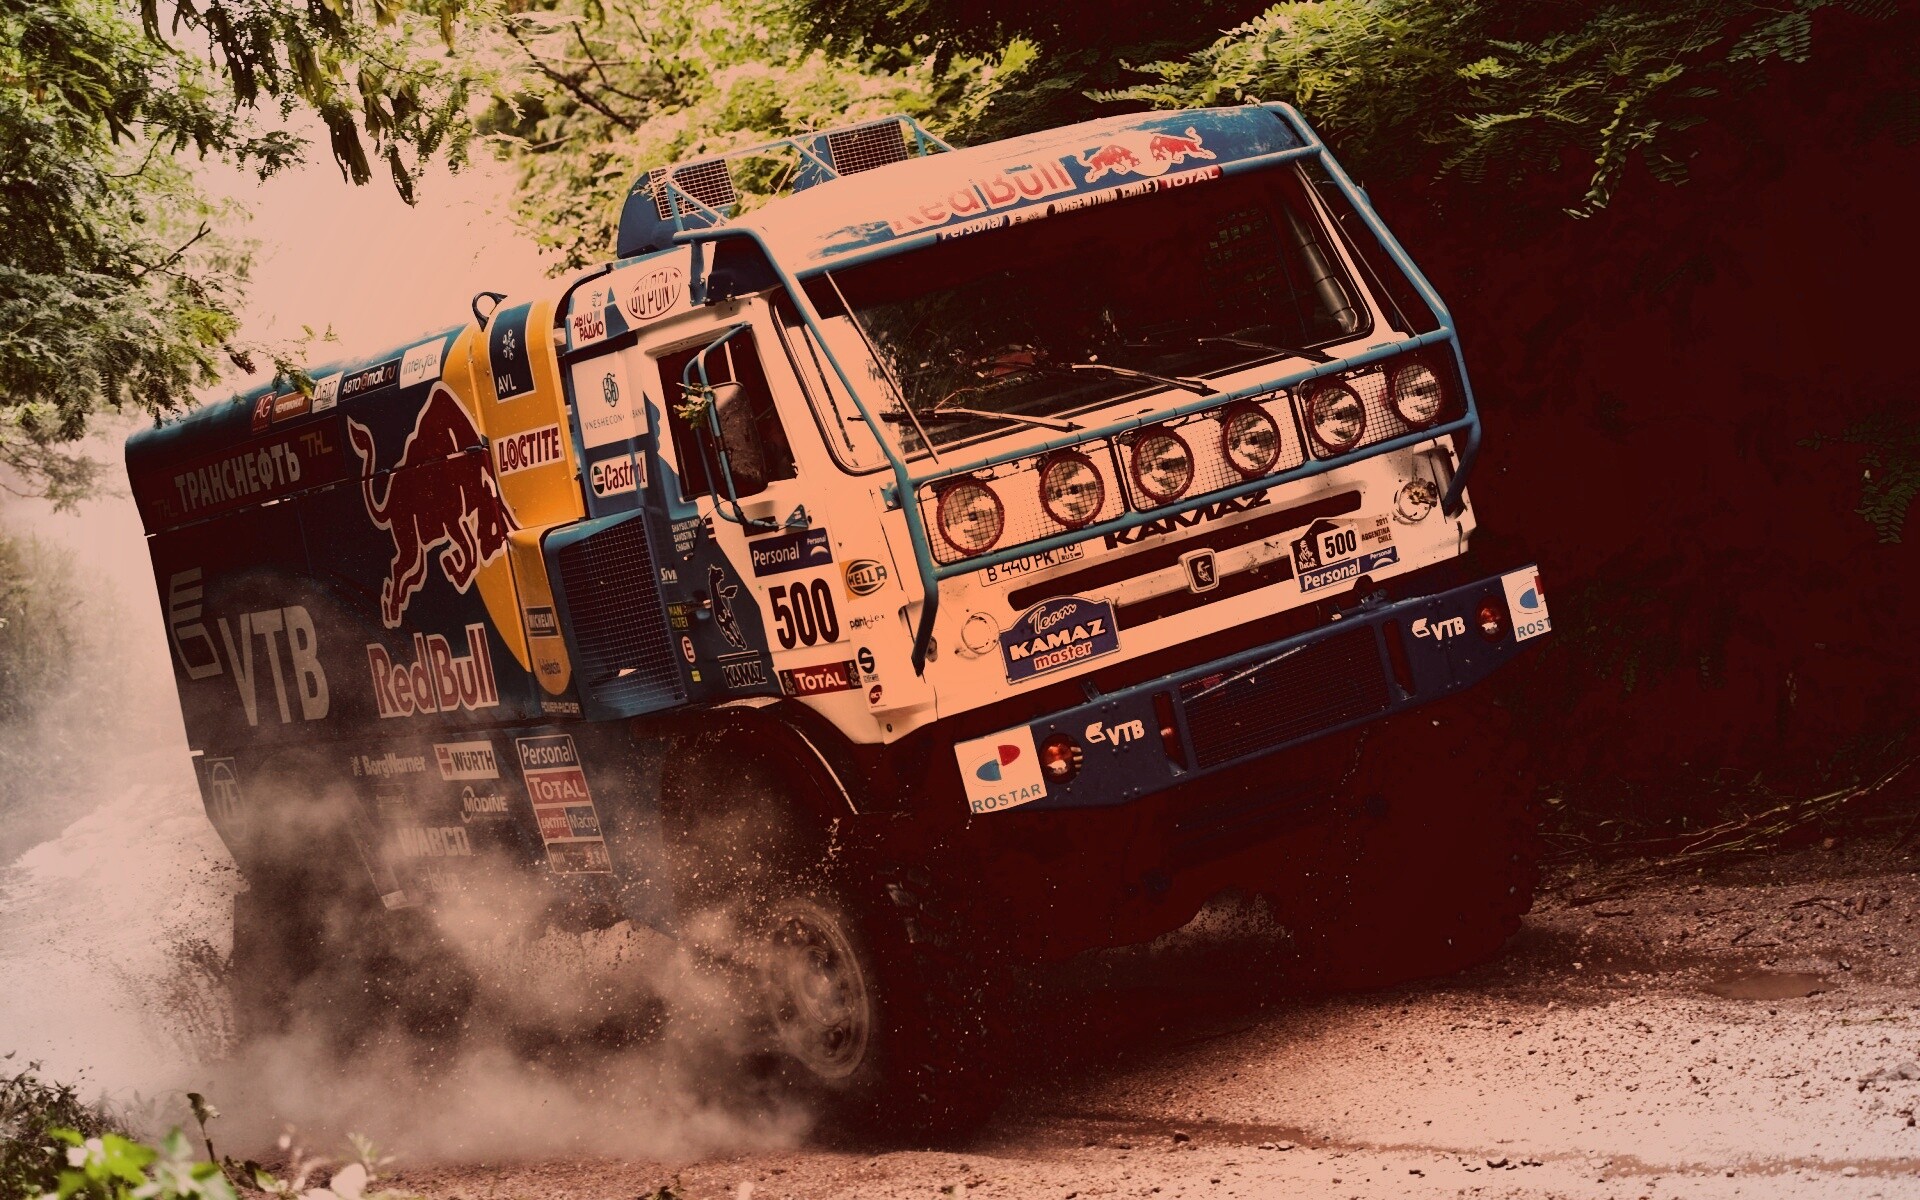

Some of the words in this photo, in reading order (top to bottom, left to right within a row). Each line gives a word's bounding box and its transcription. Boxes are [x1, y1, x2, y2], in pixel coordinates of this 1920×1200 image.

[978, 156, 1076, 208] Bull
[1166, 167, 1219, 190] TOTAL
[498, 373, 517, 395] AVL
[253, 394, 273, 422] AG
[498, 426, 560, 473] LOCTITE
[174, 441, 301, 513] ТРАНСНЕФТЬ
[1361, 526, 1391, 541] ARGENTINA
[1375, 517, 1389, 527] 2011
[806, 534, 827, 545] Personal
[1323, 529, 1357, 559] 500
[1377, 533, 1392, 544] CHILE
[752, 540, 800, 567] Personal
[1369, 547, 1392, 560] Personal
[847, 564, 888, 587] HELLA
[1303, 557, 1361, 591] Personal
[768, 578, 840, 650] 500
[1027, 603, 1077, 635] Team
[1009, 618, 1106, 661] KAMAZ
[1430, 616, 1466, 641] VTB
[217, 605, 330, 727] VTB
[1034, 641, 1093, 671] master
[366, 631, 438, 719] Red
[425, 622, 500, 711] Bull
[721, 660, 768, 689] KAMAZ
[794, 671, 847, 691] TOTAL
[1105, 719, 1145, 746] VTB
[361, 752, 426, 779] BorgWarner
[451, 749, 496, 772] WÜRTH
[521, 739, 574, 766] Personal
[528, 776, 587, 800] TOTAL
[971, 783, 1042, 814] ROSTAR
[462, 794, 509, 813] MODINE
[397, 826, 472, 856] WABCO
